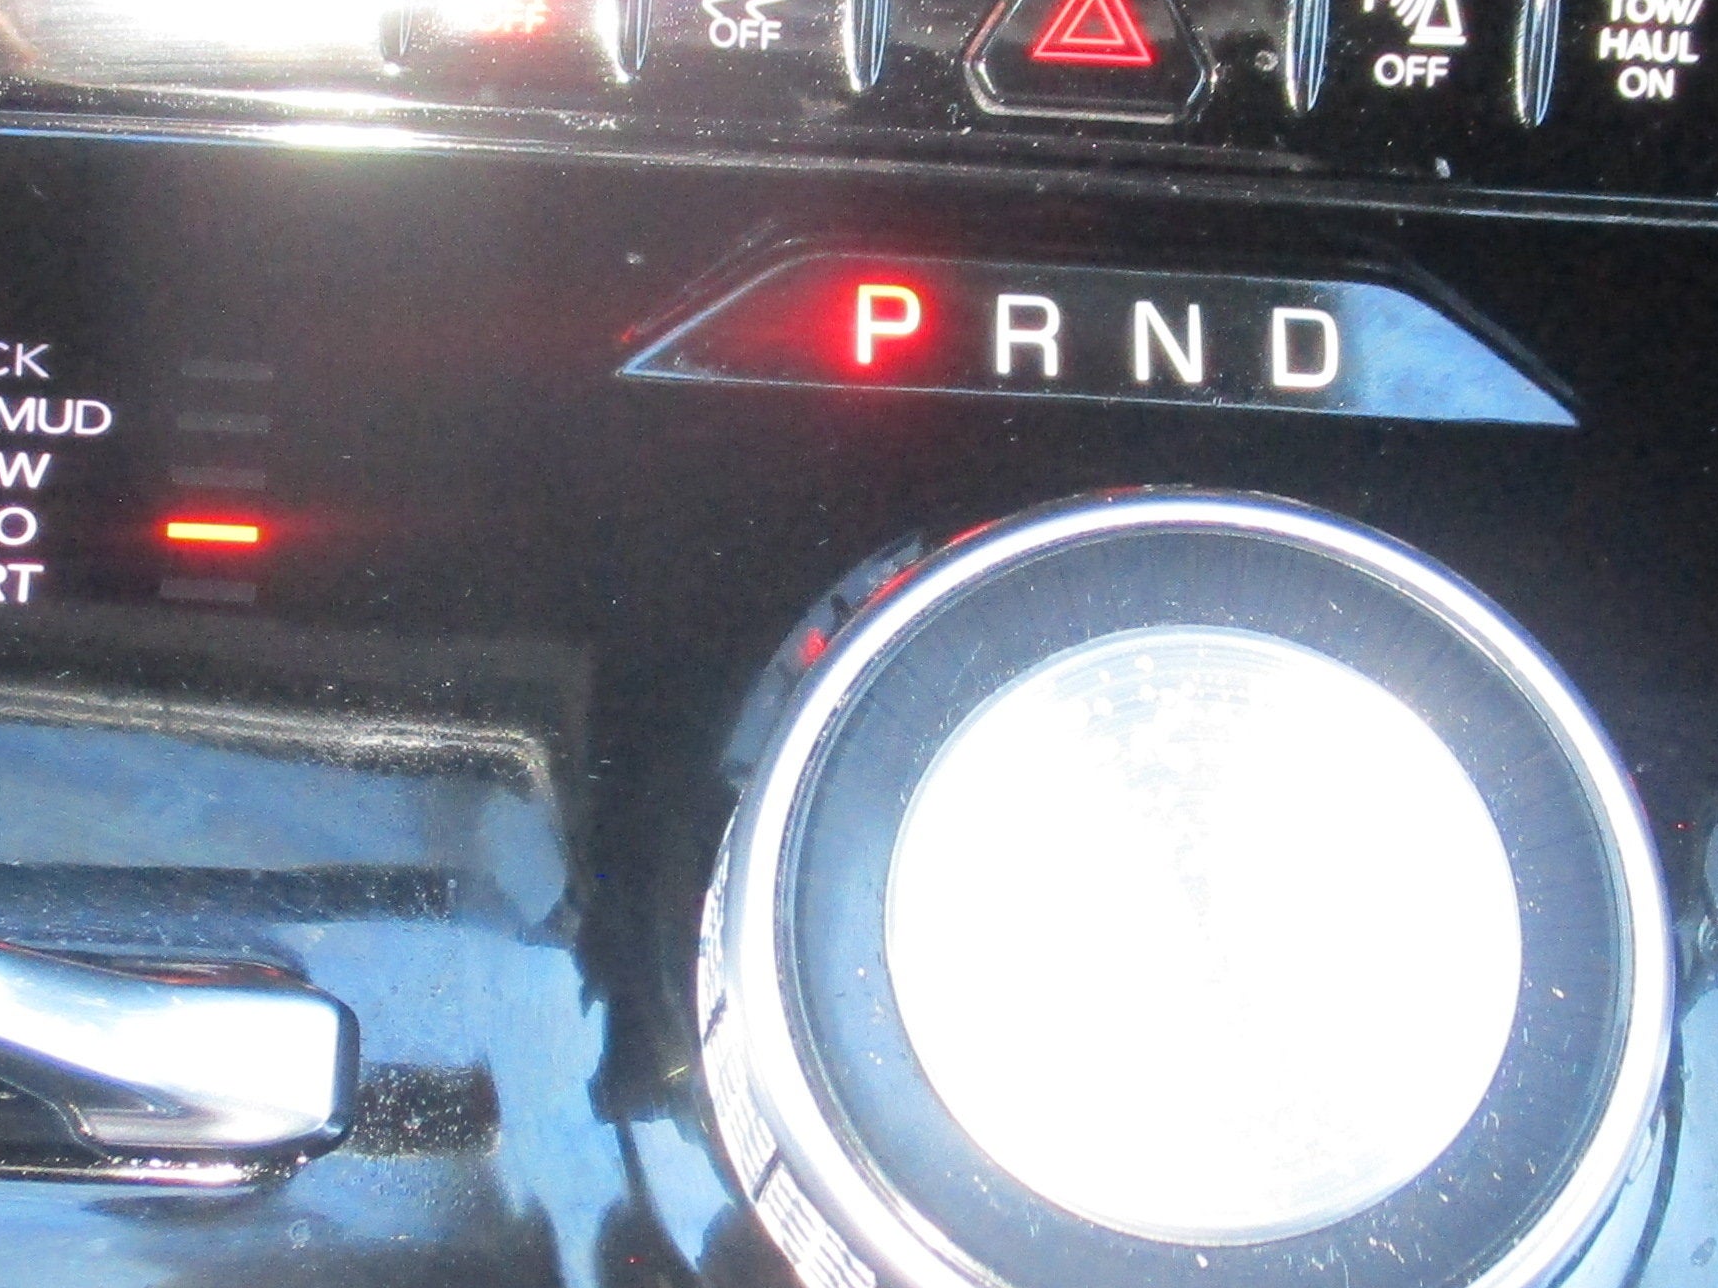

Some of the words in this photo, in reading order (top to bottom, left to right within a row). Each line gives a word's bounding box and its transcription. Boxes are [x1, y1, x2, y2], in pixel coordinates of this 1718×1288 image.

[707, 18, 783, 51] OFF
[1598, 27, 1699, 64] HAUL
[1373, 53, 1450, 88] OFF
[1617, 65, 1675, 99] ON
[854, 282, 922, 366] P
[994, 293, 1061, 378] R
[1133, 300, 1204, 385] N
[1270, 306, 1341, 390] D
